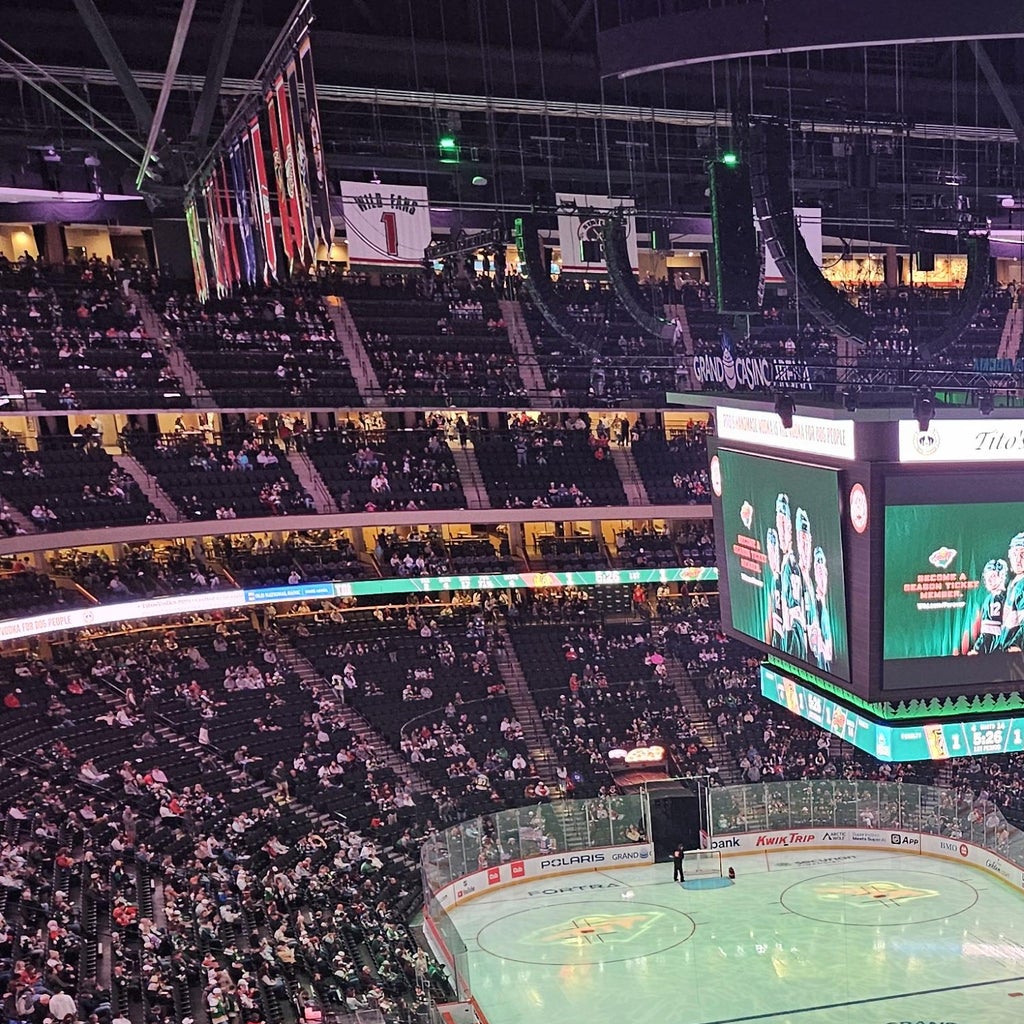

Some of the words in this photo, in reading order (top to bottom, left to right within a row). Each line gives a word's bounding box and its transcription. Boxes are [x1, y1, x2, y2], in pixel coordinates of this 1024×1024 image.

[353, 192, 383, 212] WILD
[390, 193, 419, 215] FANS
[380, 211, 398, 257] 1
[693, 354, 724, 383] GRAND
[735, 357, 774, 391] CASINO
[917, 573, 957, 583] BECOME
[959, 572, 967, 581] A
[904, 582, 942, 592] SEASON
[944, 580, 980, 590] TICKET
[265, 590, 288, 599] NATIONAL
[989, 601, 1001, 617] 12
[22, 619, 34, 632] FOR
[48, 615, 73, 628] PEOPLE
[951, 733, 960, 750] 1
[972, 730, 1001, 746] 5:26
[1013, 728, 1022, 745] 1
[788, 832, 815, 844] TRIP
[940, 842, 957, 852] BMO
[541, 853, 605, 869] POLARIS
[612, 852, 639, 861] GRAND
[528, 883, 620, 897] FORTRA
